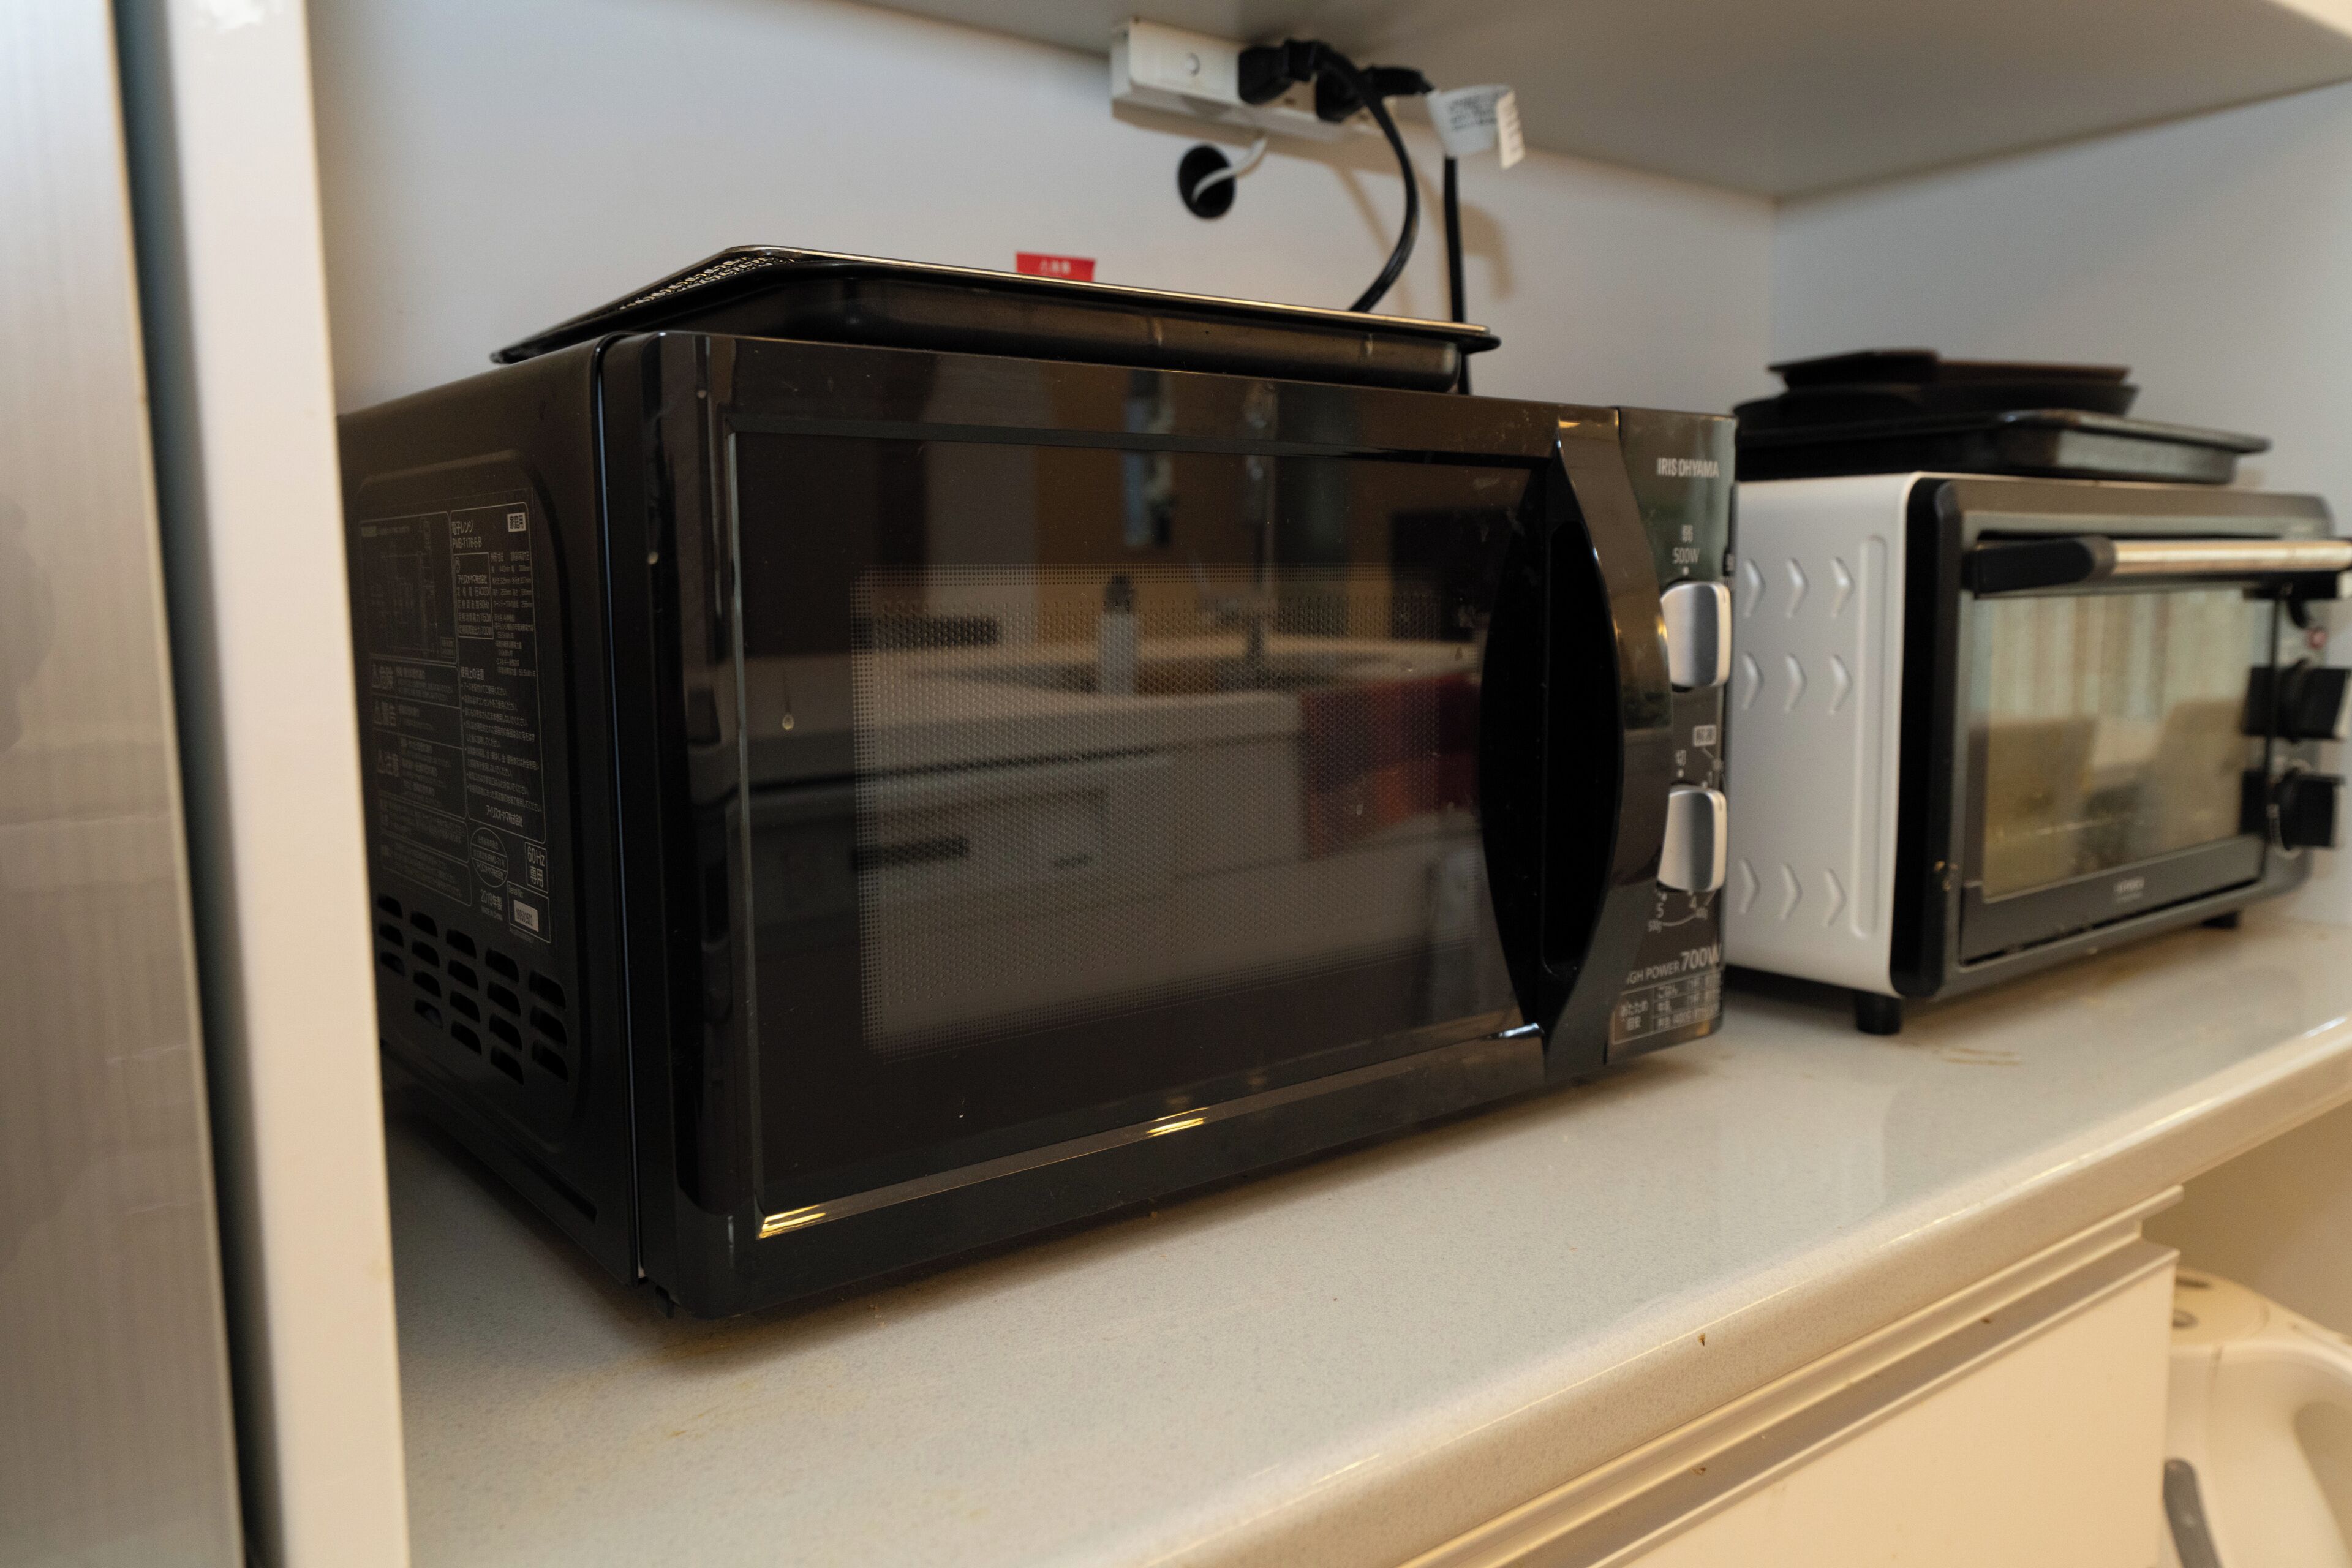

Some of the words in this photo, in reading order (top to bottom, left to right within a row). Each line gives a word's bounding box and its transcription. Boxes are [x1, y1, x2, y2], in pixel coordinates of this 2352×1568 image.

[1657, 458, 1677, 477] IRIS
[1678, 458, 1719, 477] OHYAMA
[1673, 547, 1700, 564] 500W
[527, 846, 546, 867] 60Hz
[530, 865, 543, 888] 専用
[1656, 902, 1664, 919] 5
[1627, 970, 1644, 984] IGH
[1645, 960, 1681, 980] POWER
[1681, 944, 1722, 970] 700W
